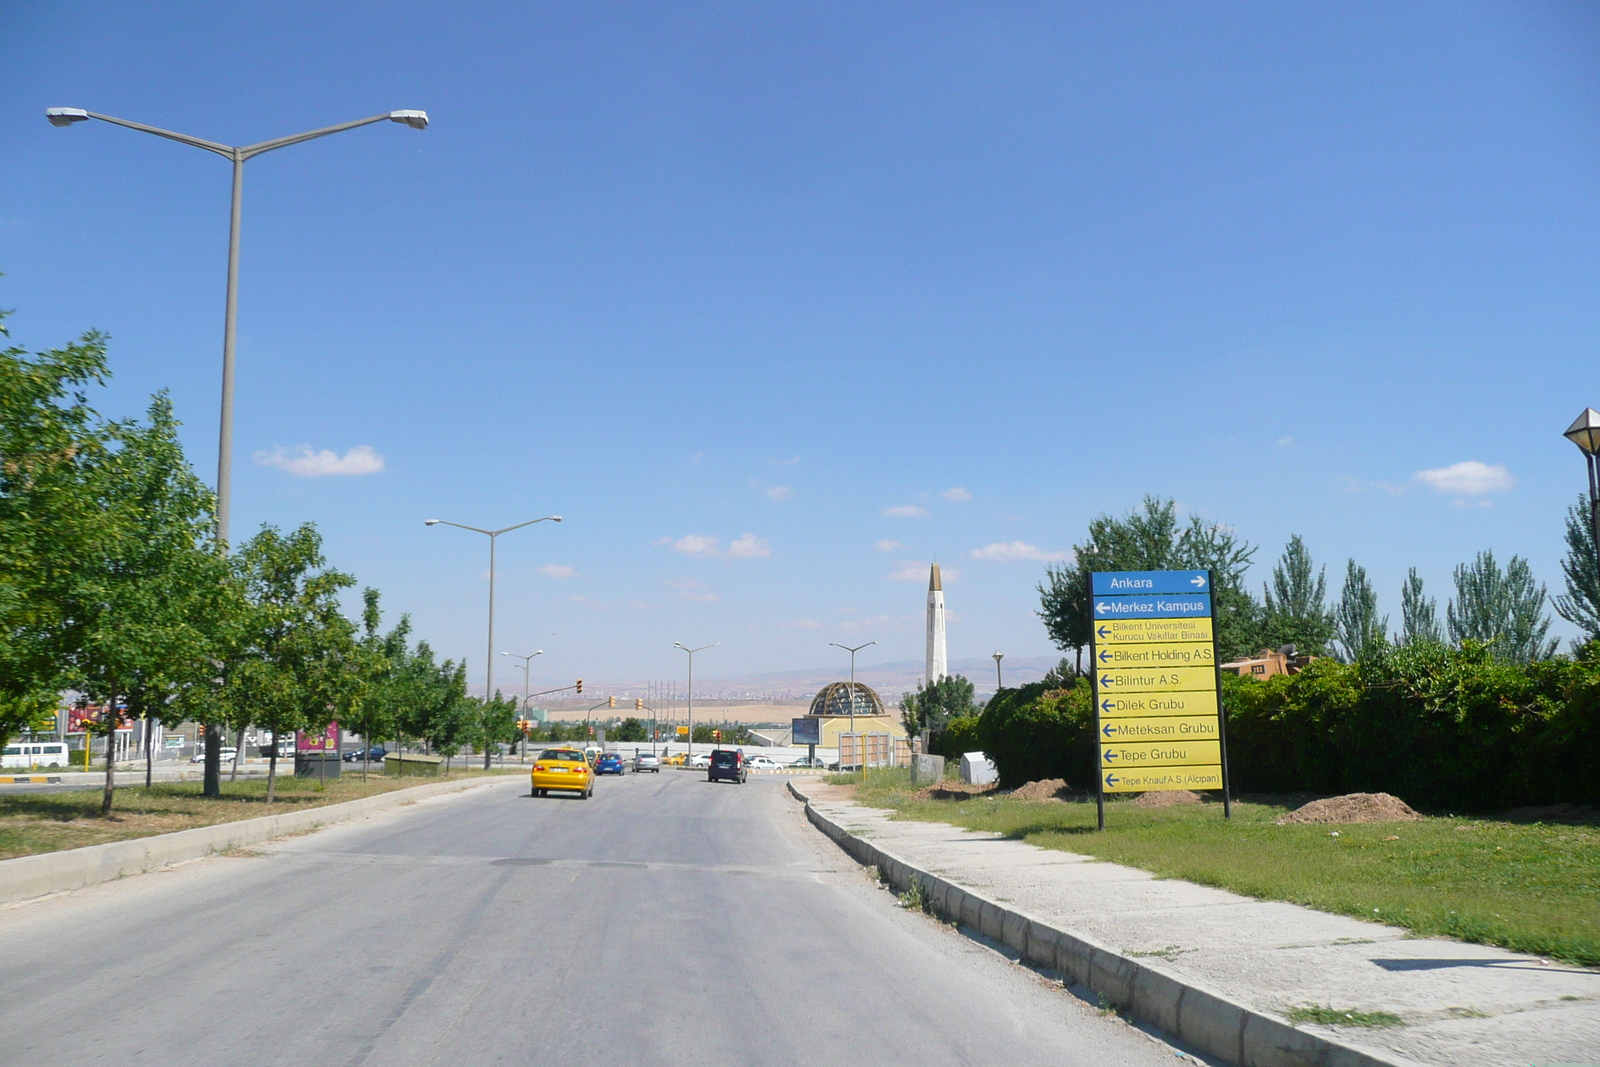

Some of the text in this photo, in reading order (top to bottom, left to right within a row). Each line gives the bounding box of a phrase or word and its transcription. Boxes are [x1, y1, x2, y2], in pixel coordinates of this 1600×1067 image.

[1110, 578, 1153, 588] Ankara
[1111, 601, 1204, 613] Merkez Kampus
[1112, 622, 1143, 631] Bilkent
[1113, 633, 1144, 641] Kurucu
[1114, 650, 1149, 661] Bilkent
[1152, 650, 1190, 662] Holding
[1115, 675, 1155, 686] Bilintur
[1116, 699, 1185, 711] Dilek Grubu
[1117, 723, 1214, 736] Meteksan Grubu
[1119, 748, 1186, 762] Tepe Grubu
[1122, 776, 1140, 786] Tepe
[1143, 776, 1166, 785] Knauf
